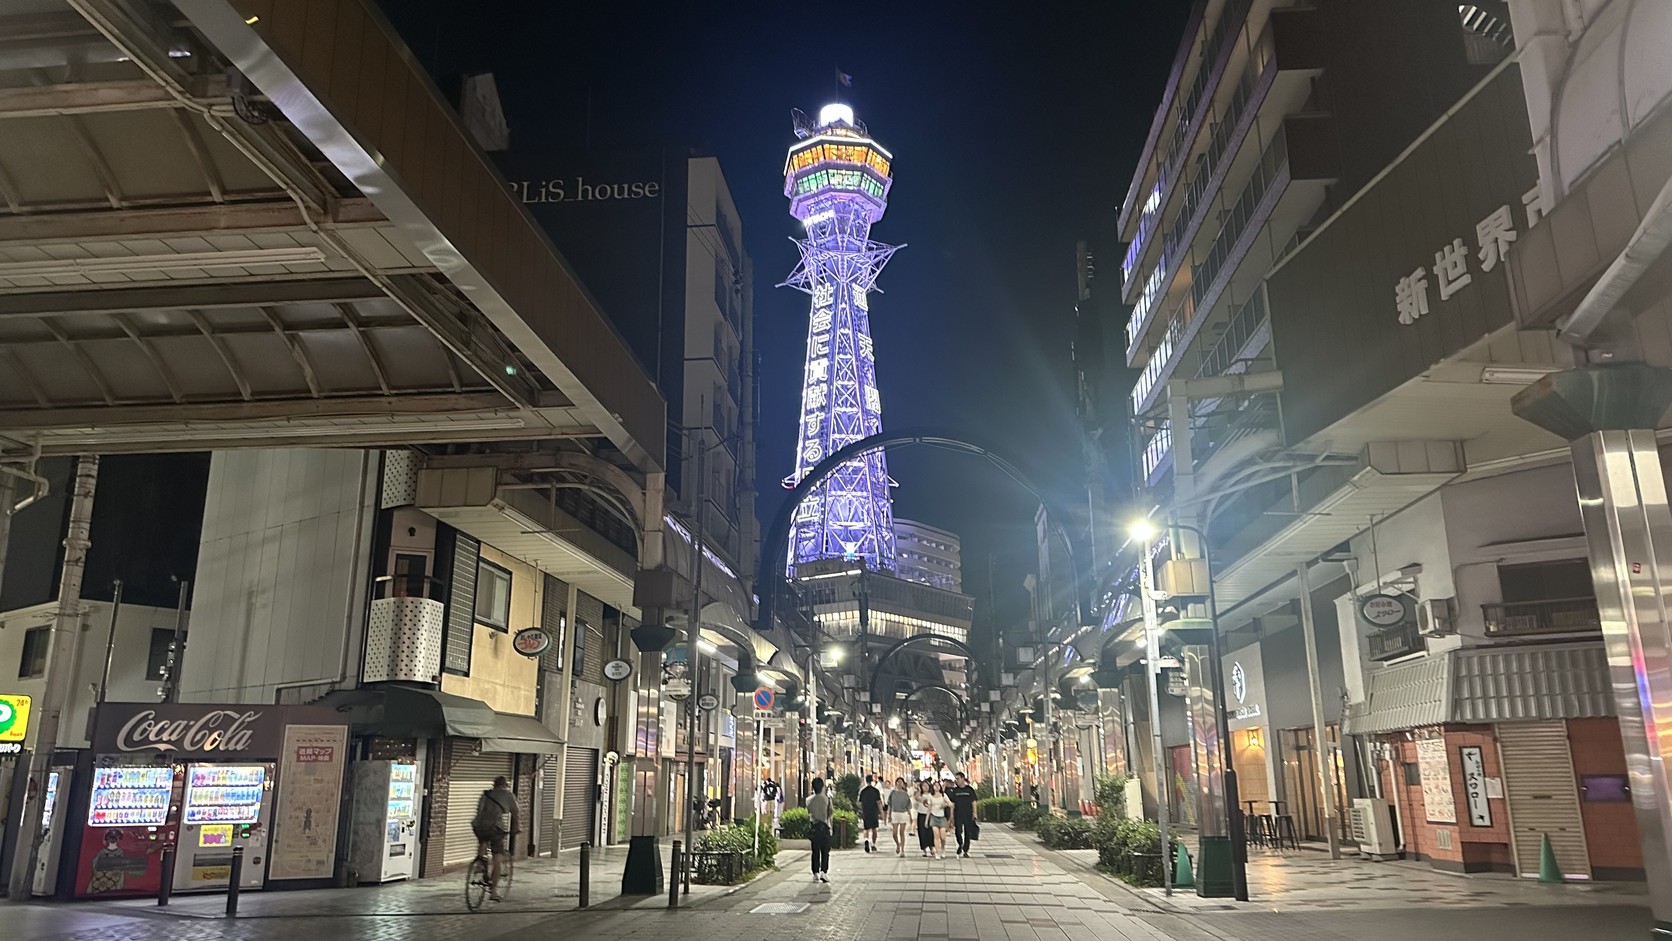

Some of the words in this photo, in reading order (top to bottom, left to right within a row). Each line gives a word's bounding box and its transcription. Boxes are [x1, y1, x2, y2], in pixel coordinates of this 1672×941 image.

[509, 177, 660, 204] LiS_house
[1373, 609, 1400, 620] スワロー
[116, 710, 263, 751] Coca-Cola
[1468, 772, 1479, 810] スワロー
